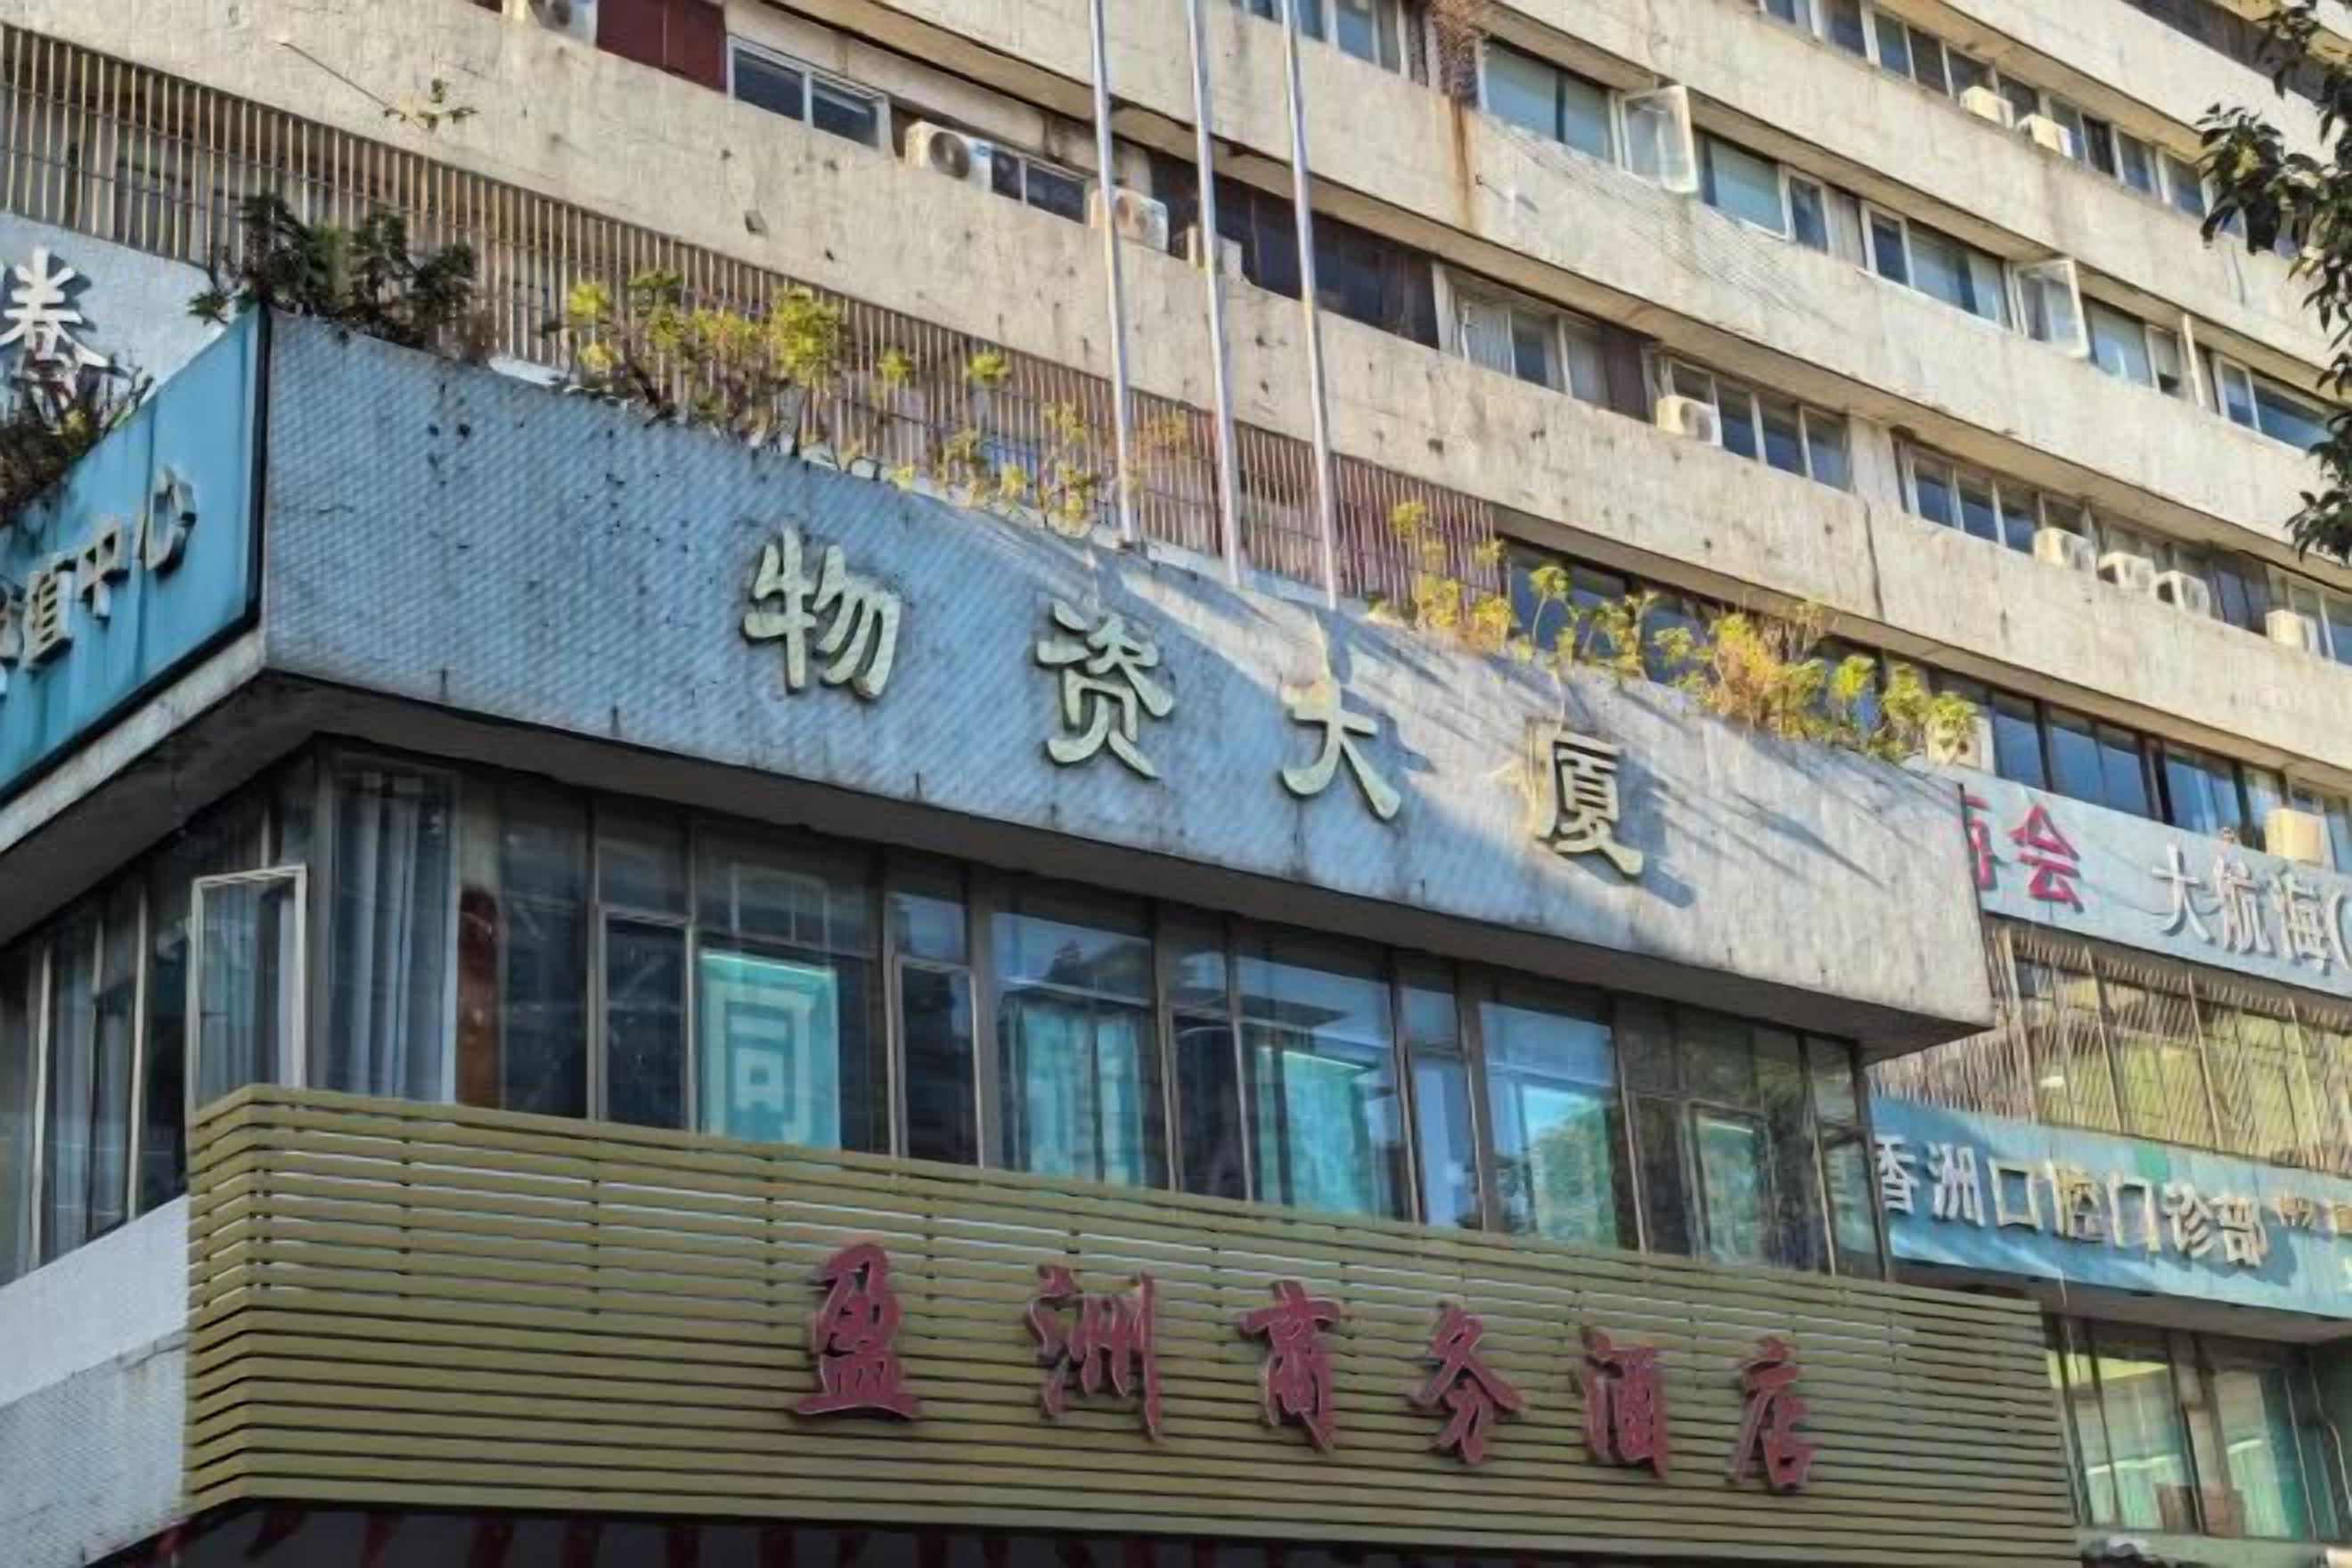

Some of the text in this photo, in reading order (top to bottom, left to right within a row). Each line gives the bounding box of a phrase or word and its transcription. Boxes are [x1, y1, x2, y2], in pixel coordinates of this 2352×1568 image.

[743, 524, 1645, 875] 物资大厦
[1874, 1134, 2266, 1267] 香洲口腔门诊部
[791, 1242, 1816, 1490] 盈洲商务酒店
